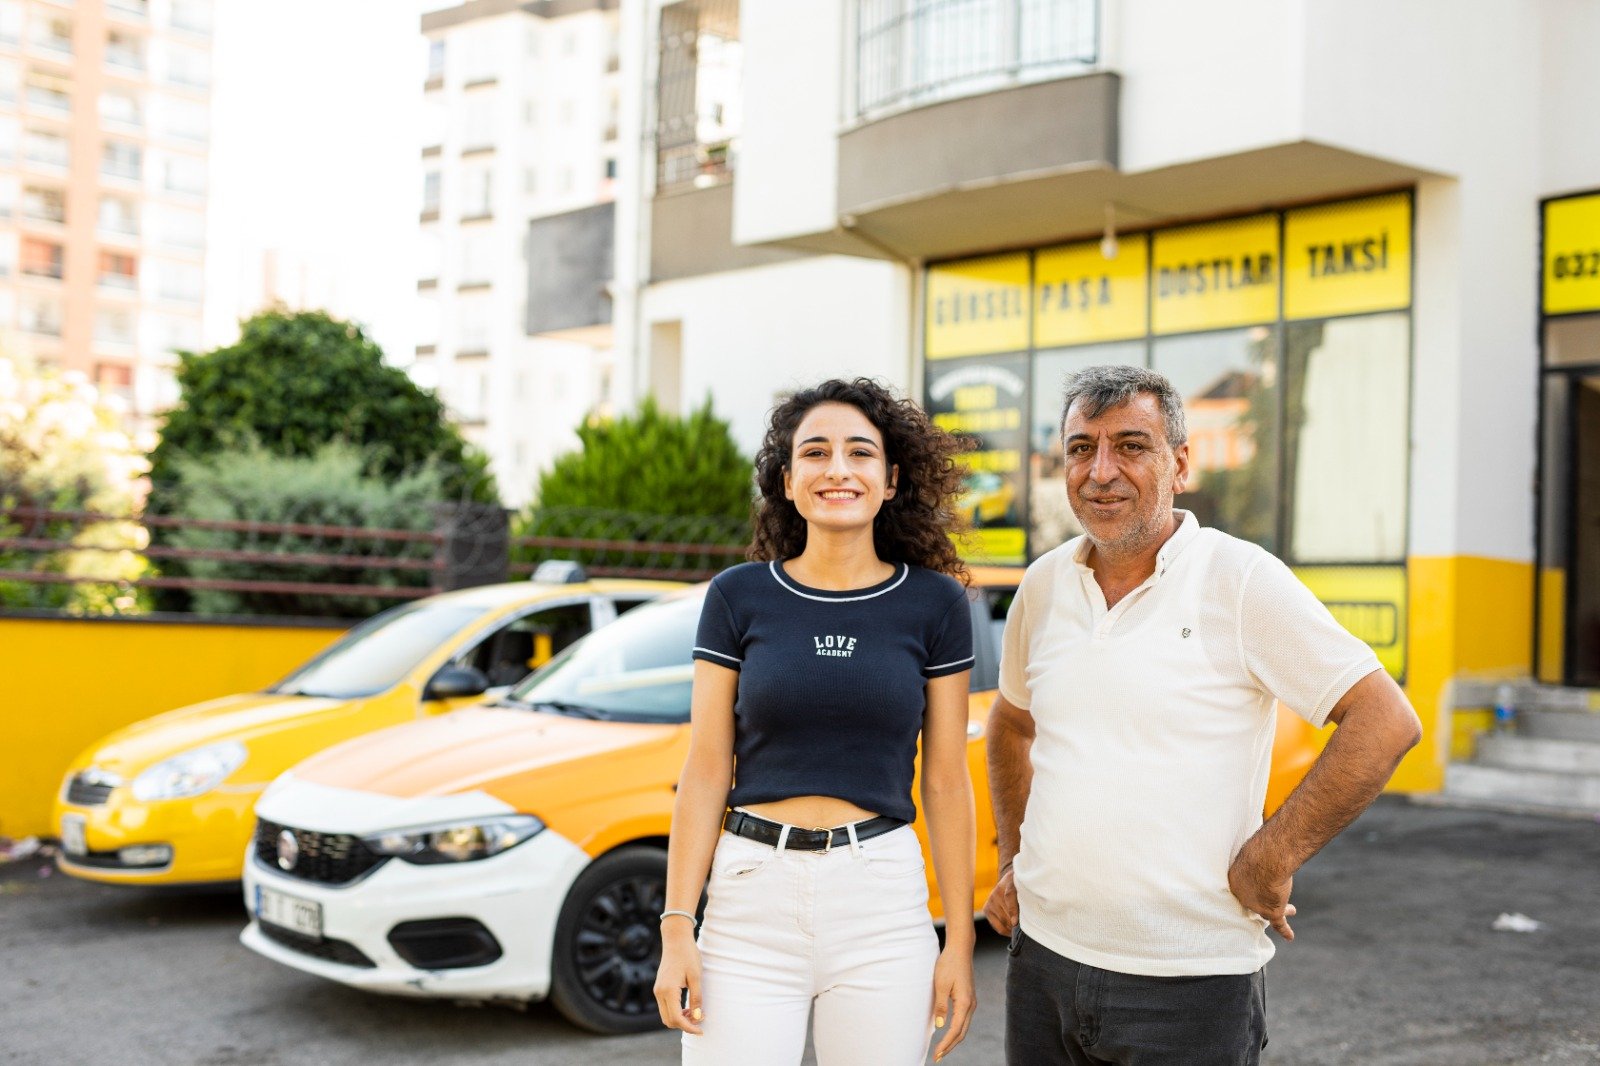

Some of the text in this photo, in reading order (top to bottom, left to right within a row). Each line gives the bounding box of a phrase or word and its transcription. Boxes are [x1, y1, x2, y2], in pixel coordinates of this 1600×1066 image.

[1040, 274, 1112, 313] PAŞA
[1158, 252, 1273, 297] DOSTLAR
[1306, 228, 1389, 278] TAKSİ
[814, 635, 857, 650] LOVE
[816, 649, 852, 657] ACADEMY
